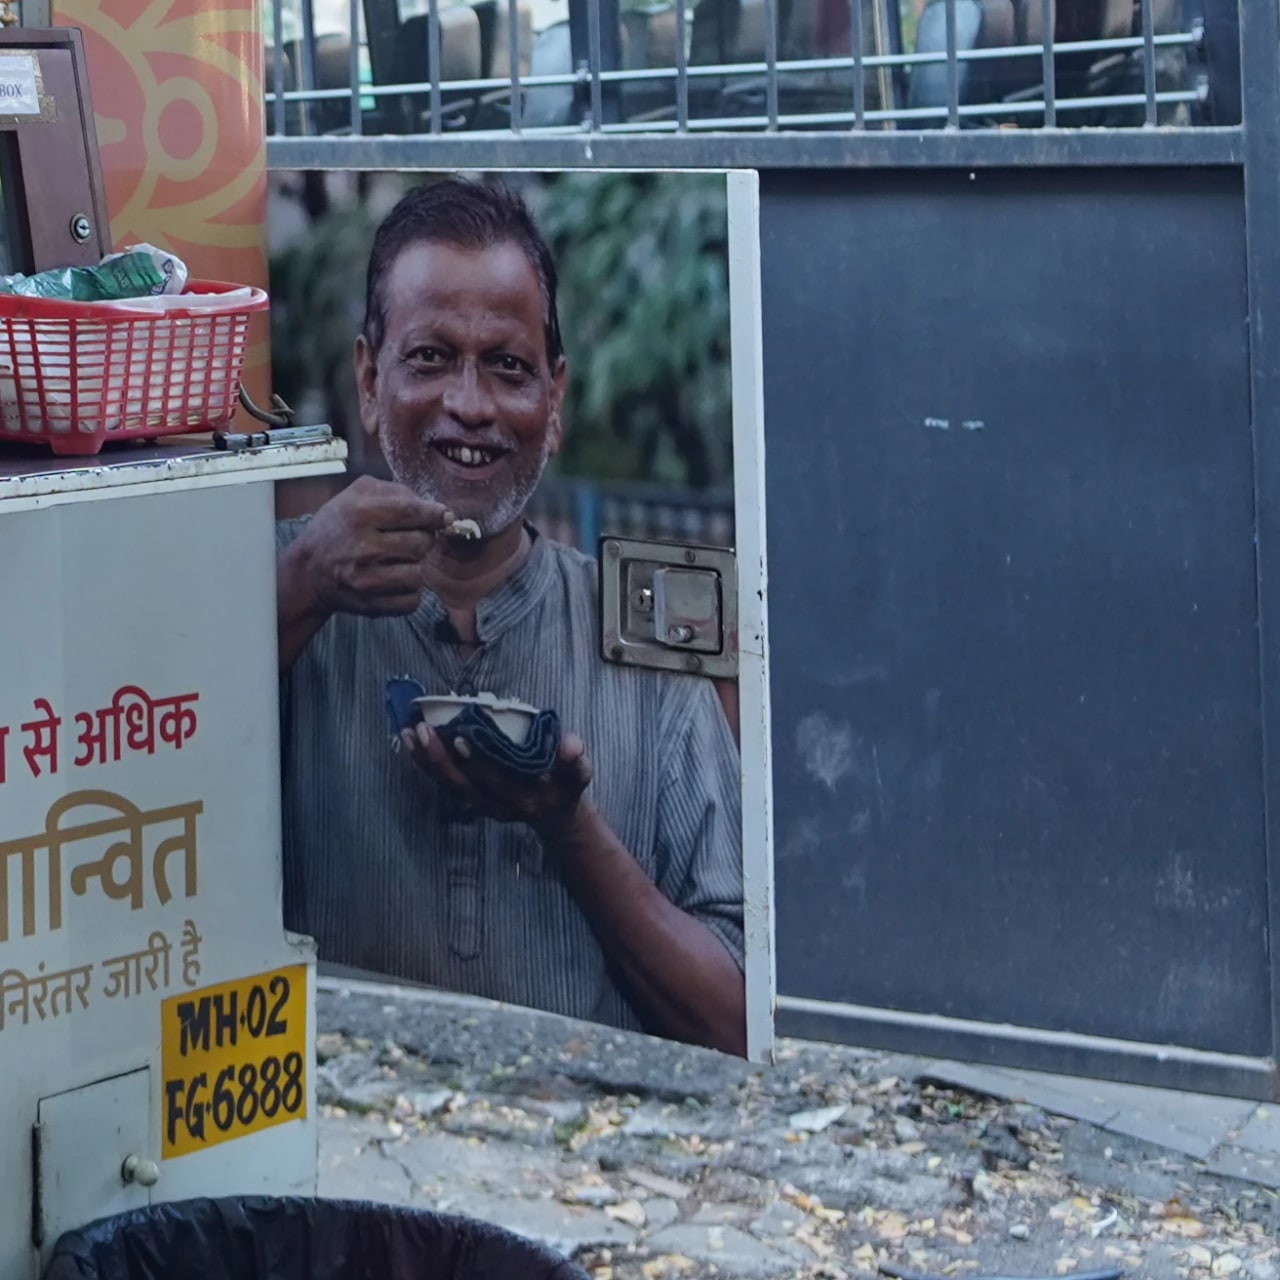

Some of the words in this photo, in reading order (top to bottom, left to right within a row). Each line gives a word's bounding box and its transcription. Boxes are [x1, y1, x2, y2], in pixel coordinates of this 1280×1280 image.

[0, 83, 23, 98] BOX
[21, 698, 62, 778] से
[74, 685, 199, 767] अधिक
[102, 931, 173, 999] जारी
[180, 919, 203, 987] है
